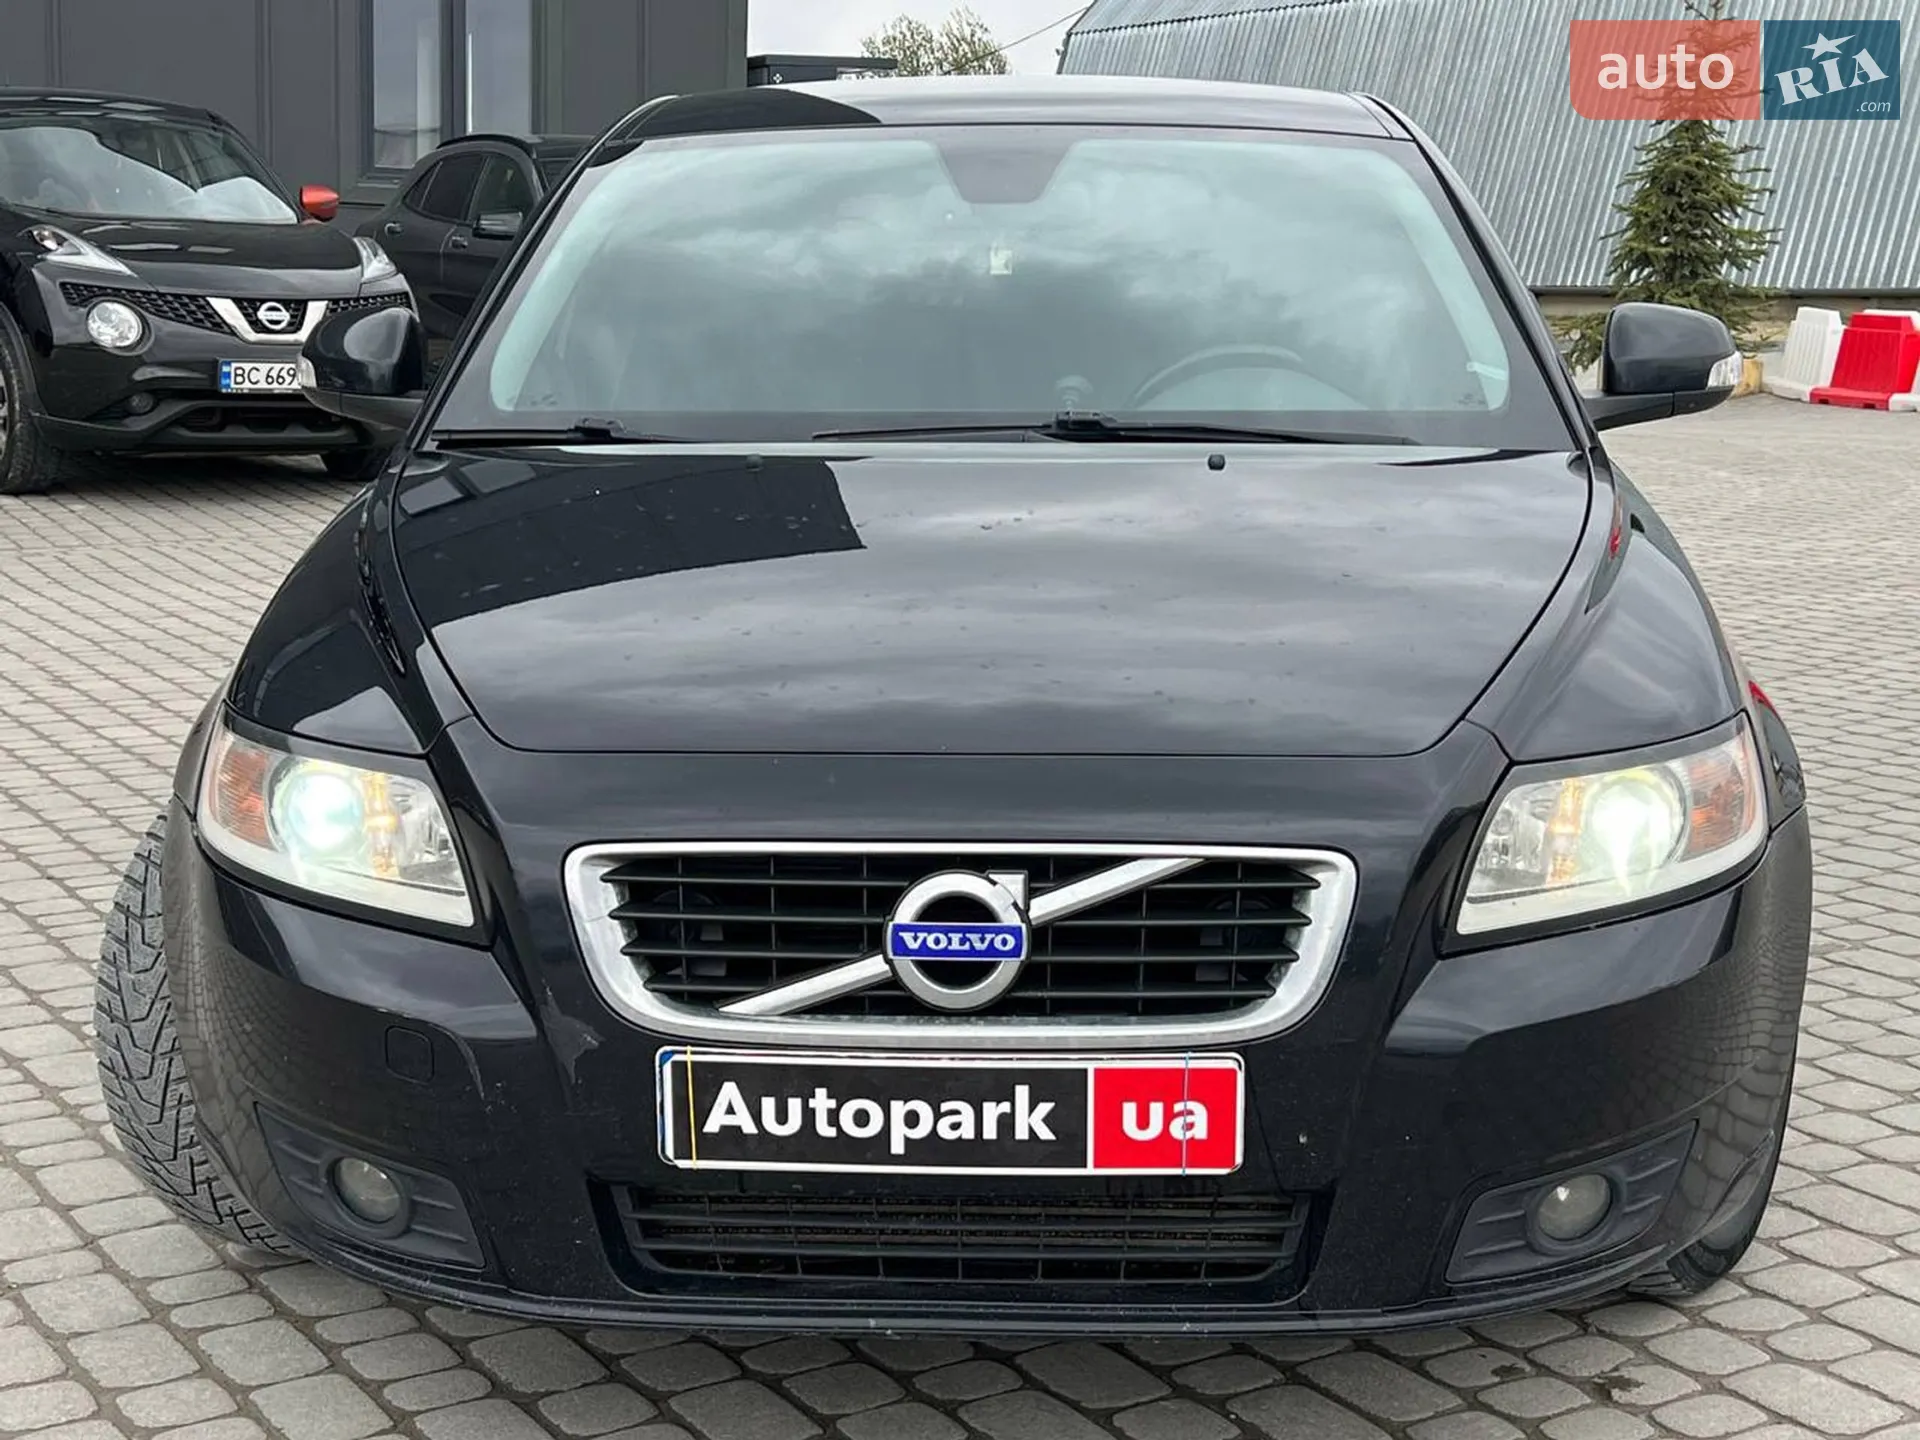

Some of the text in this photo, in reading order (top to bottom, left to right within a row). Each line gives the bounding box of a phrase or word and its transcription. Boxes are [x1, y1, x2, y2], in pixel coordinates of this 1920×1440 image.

[898, 932, 1016, 951] VOLVO
[702, 1081, 1209, 1155] Autopark ua
